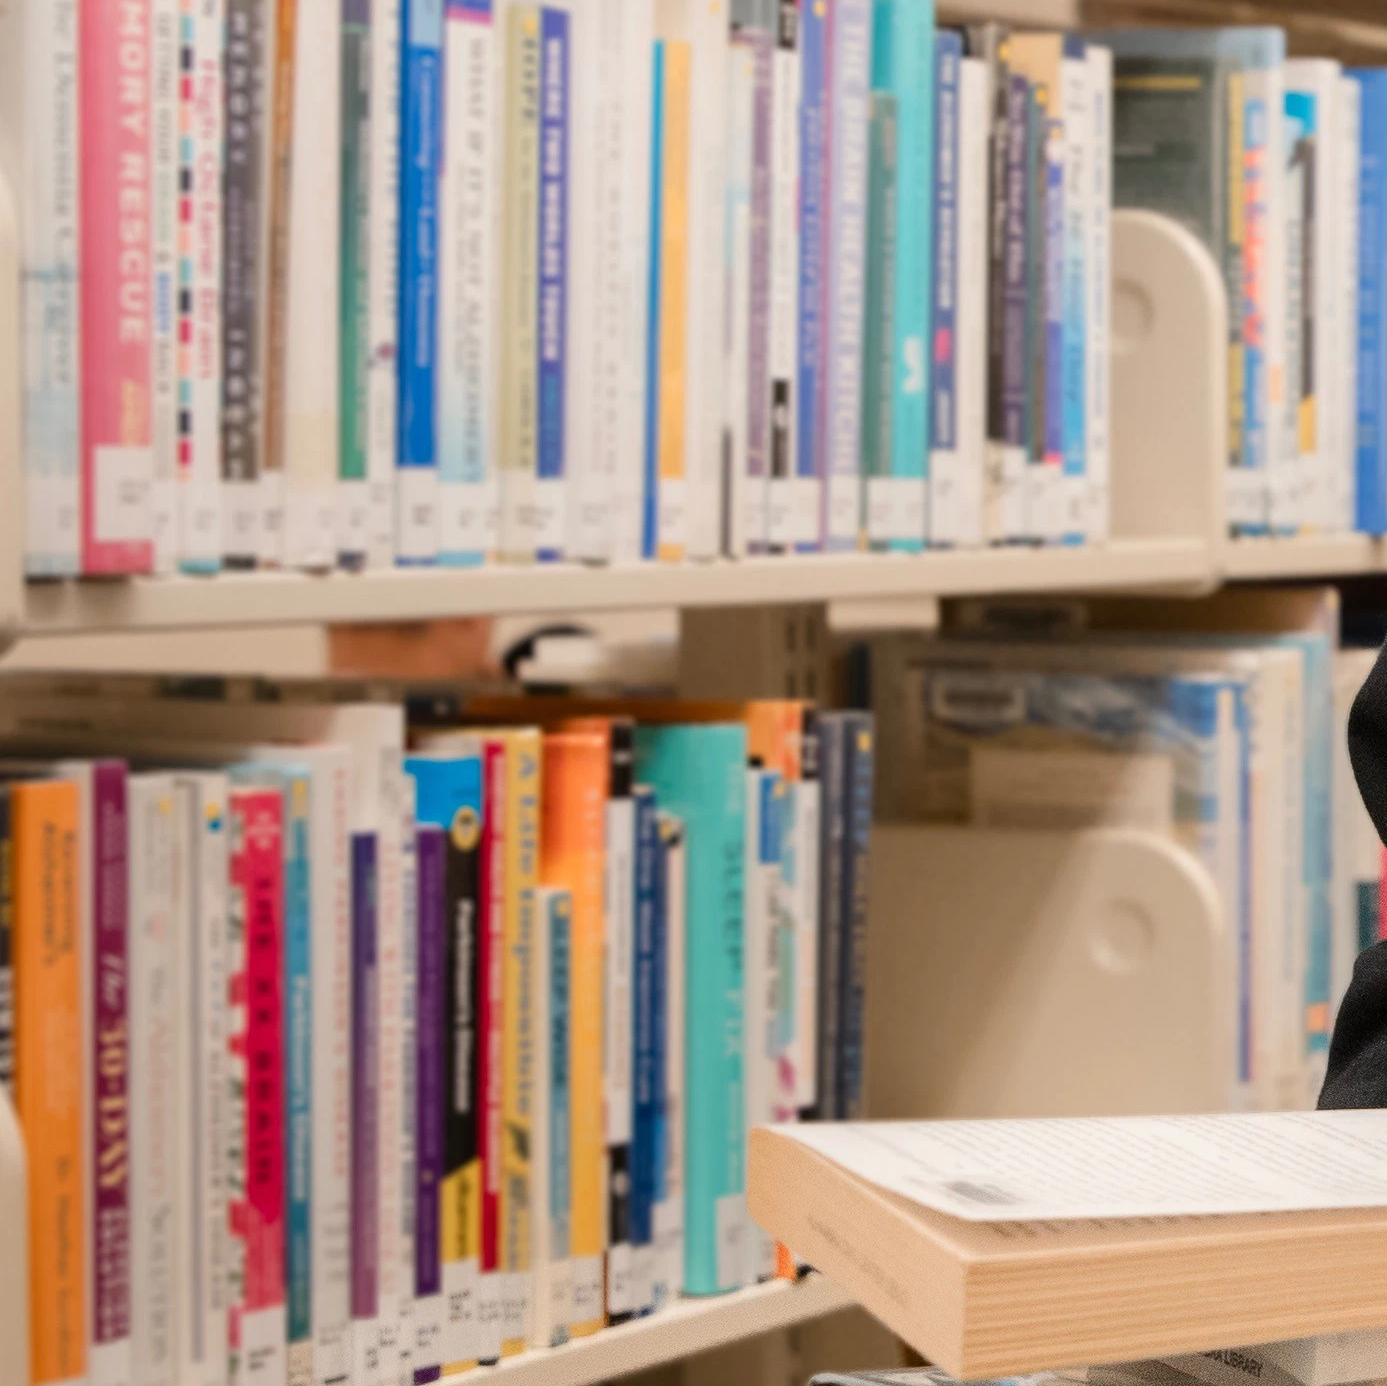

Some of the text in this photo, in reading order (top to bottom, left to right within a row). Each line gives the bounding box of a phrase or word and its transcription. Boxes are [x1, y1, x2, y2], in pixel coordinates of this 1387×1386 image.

[545, 38, 562, 361] WHERE TWO WORLDS TOUCH
[841, 98, 861, 204] BRAIN
[121, 150, 145, 344] RESCUE
[841, 215, 861, 343] HEALTH
[520, 794, 538, 876] Life
[721, 841, 746, 970] SLEEP
[101, 953, 129, 1012] The
[455, 898, 474, 1112] Parkinson's Disease
[511, 888, 538, 1118] Impossible
[101, 1018, 129, 1188] 30-DAY
[290, 975, 309, 1203] Parkinson's Disease
